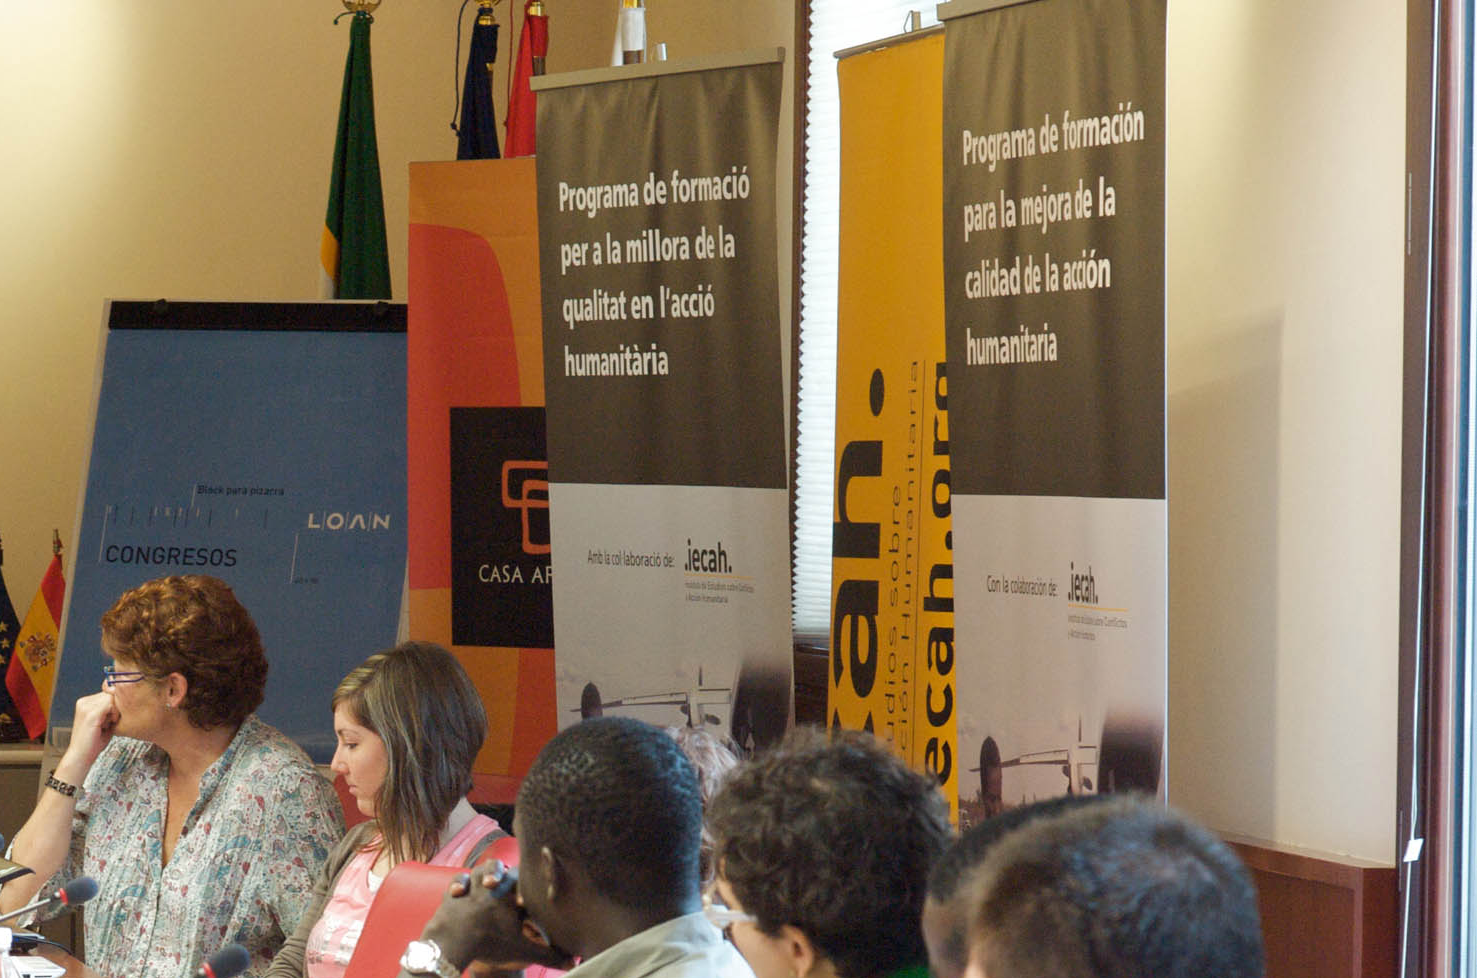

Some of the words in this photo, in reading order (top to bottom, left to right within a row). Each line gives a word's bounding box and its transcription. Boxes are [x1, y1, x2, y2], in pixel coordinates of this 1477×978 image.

[963, 127, 1036, 172] Programa
[1039, 113, 1059, 154] de
[1062, 101, 1144, 150] formación
[559, 181, 639, 218] Programa
[643, 172, 667, 205] de
[671, 166, 750, 203] formació
[964, 202, 997, 243] para
[1000, 189, 1016, 228] la
[1021, 184, 1072, 235] mejora
[1074, 178, 1092, 219] de
[1098, 176, 1116, 217] la
[560, 242, 588, 275] per
[592, 241, 602, 265] a
[606, 232, 621, 264] la
[626, 229, 690, 263] millora
[695, 226, 715, 259] de
[718, 225, 736, 258] la
[965, 256, 1020, 299] calidad
[1024, 254, 1041, 295] de
[1045, 253, 1059, 292] la
[1063, 249, 1111, 291] acción
[562, 289, 627, 330] qualitat
[631, 294, 654, 319] en
[660, 284, 715, 318] l'acció
[564, 343, 669, 377] humanitària
[966, 322, 1057, 366] humanitaria
[105, 545, 237, 567] CONGRESOS
[831, 368, 885, 732] ah.
[888, 486, 901, 607] sobre
[478, 564, 524, 584] CASA
[986, 574, 1001, 593] Con
[1002, 575, 1009, 594] la
[885, 626, 898, 742] udios
[898, 662, 909, 750] ción
